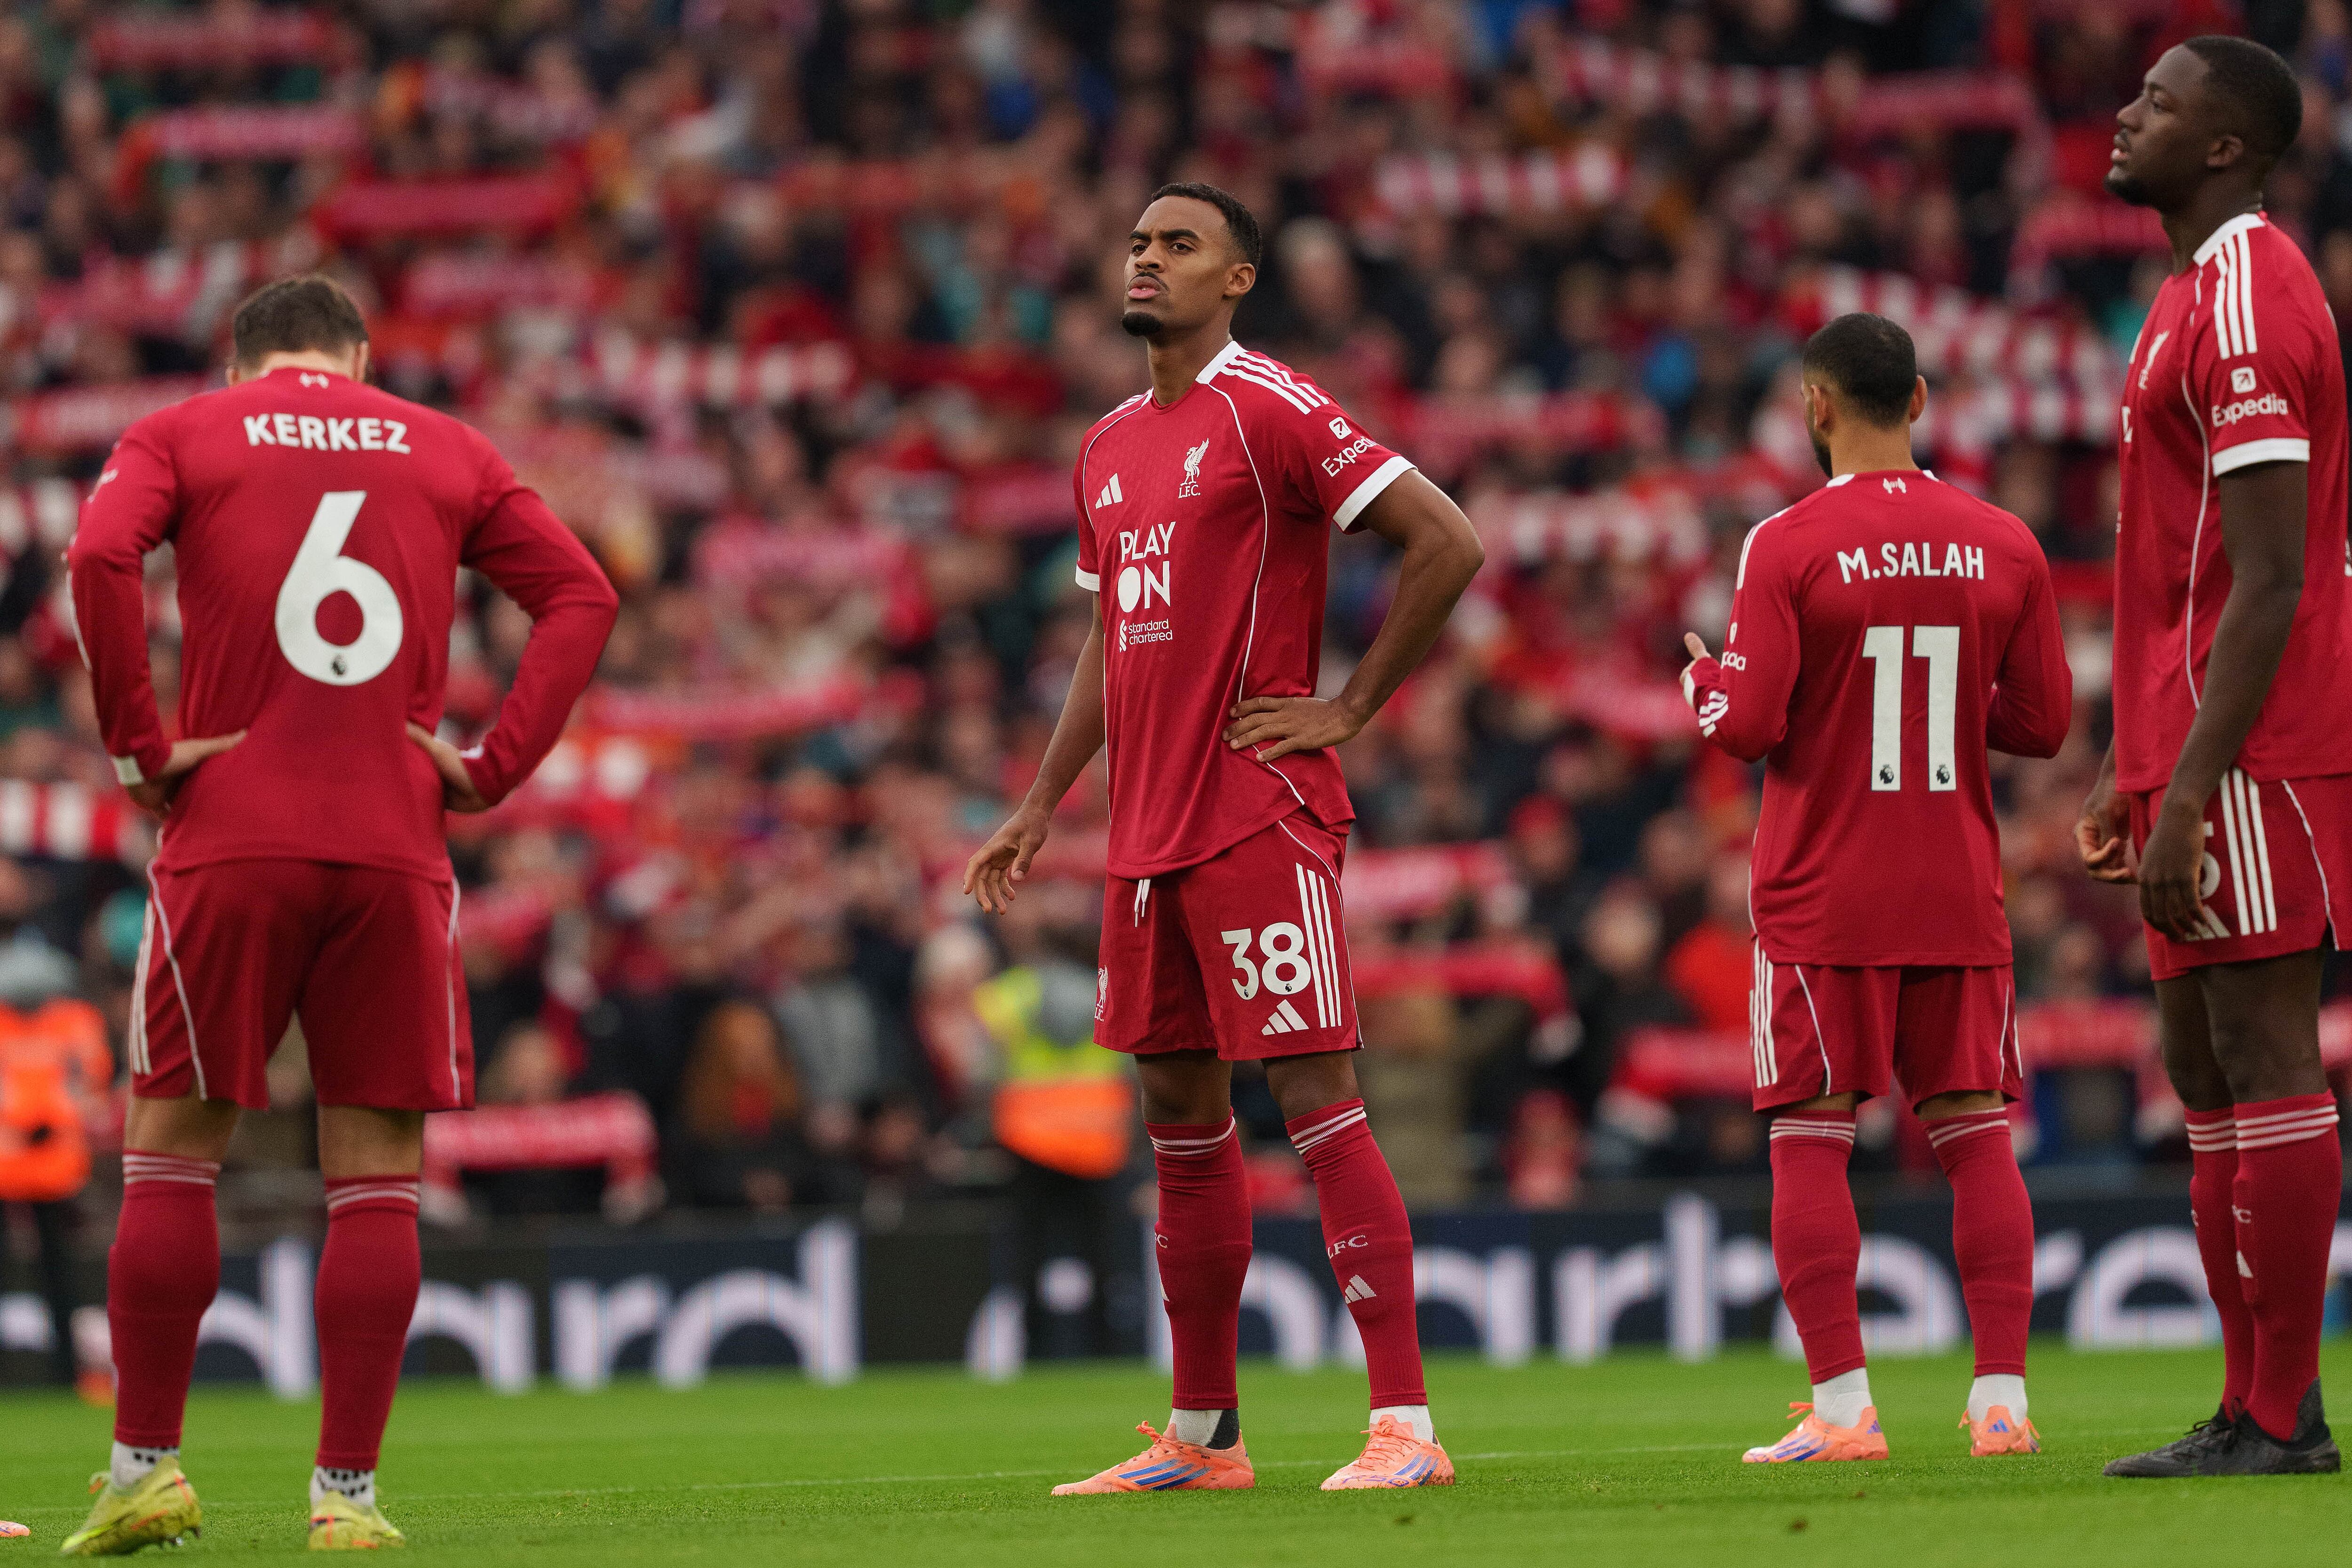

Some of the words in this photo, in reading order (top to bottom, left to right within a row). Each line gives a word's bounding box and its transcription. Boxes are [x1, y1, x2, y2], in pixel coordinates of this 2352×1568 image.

[2211, 392, 2289, 428] Expedia
[243, 413, 412, 454] KERKEZ
[1321, 435, 1378, 478] Exped
[1178, 484, 1201, 499] L.F.C.
[1119, 521, 1176, 564] PLAY
[1837, 542, 1985, 584] M.SALAH
[274, 490, 404, 686] 6
[1118, 560, 1171, 613] ON
[1128, 618, 1169, 634] standard
[1129, 629, 1173, 645] chartered
[1862, 625, 1961, 792] 11
[1221, 922, 1311, 1001] 38
[1327, 1234, 1368, 1259] LFC
